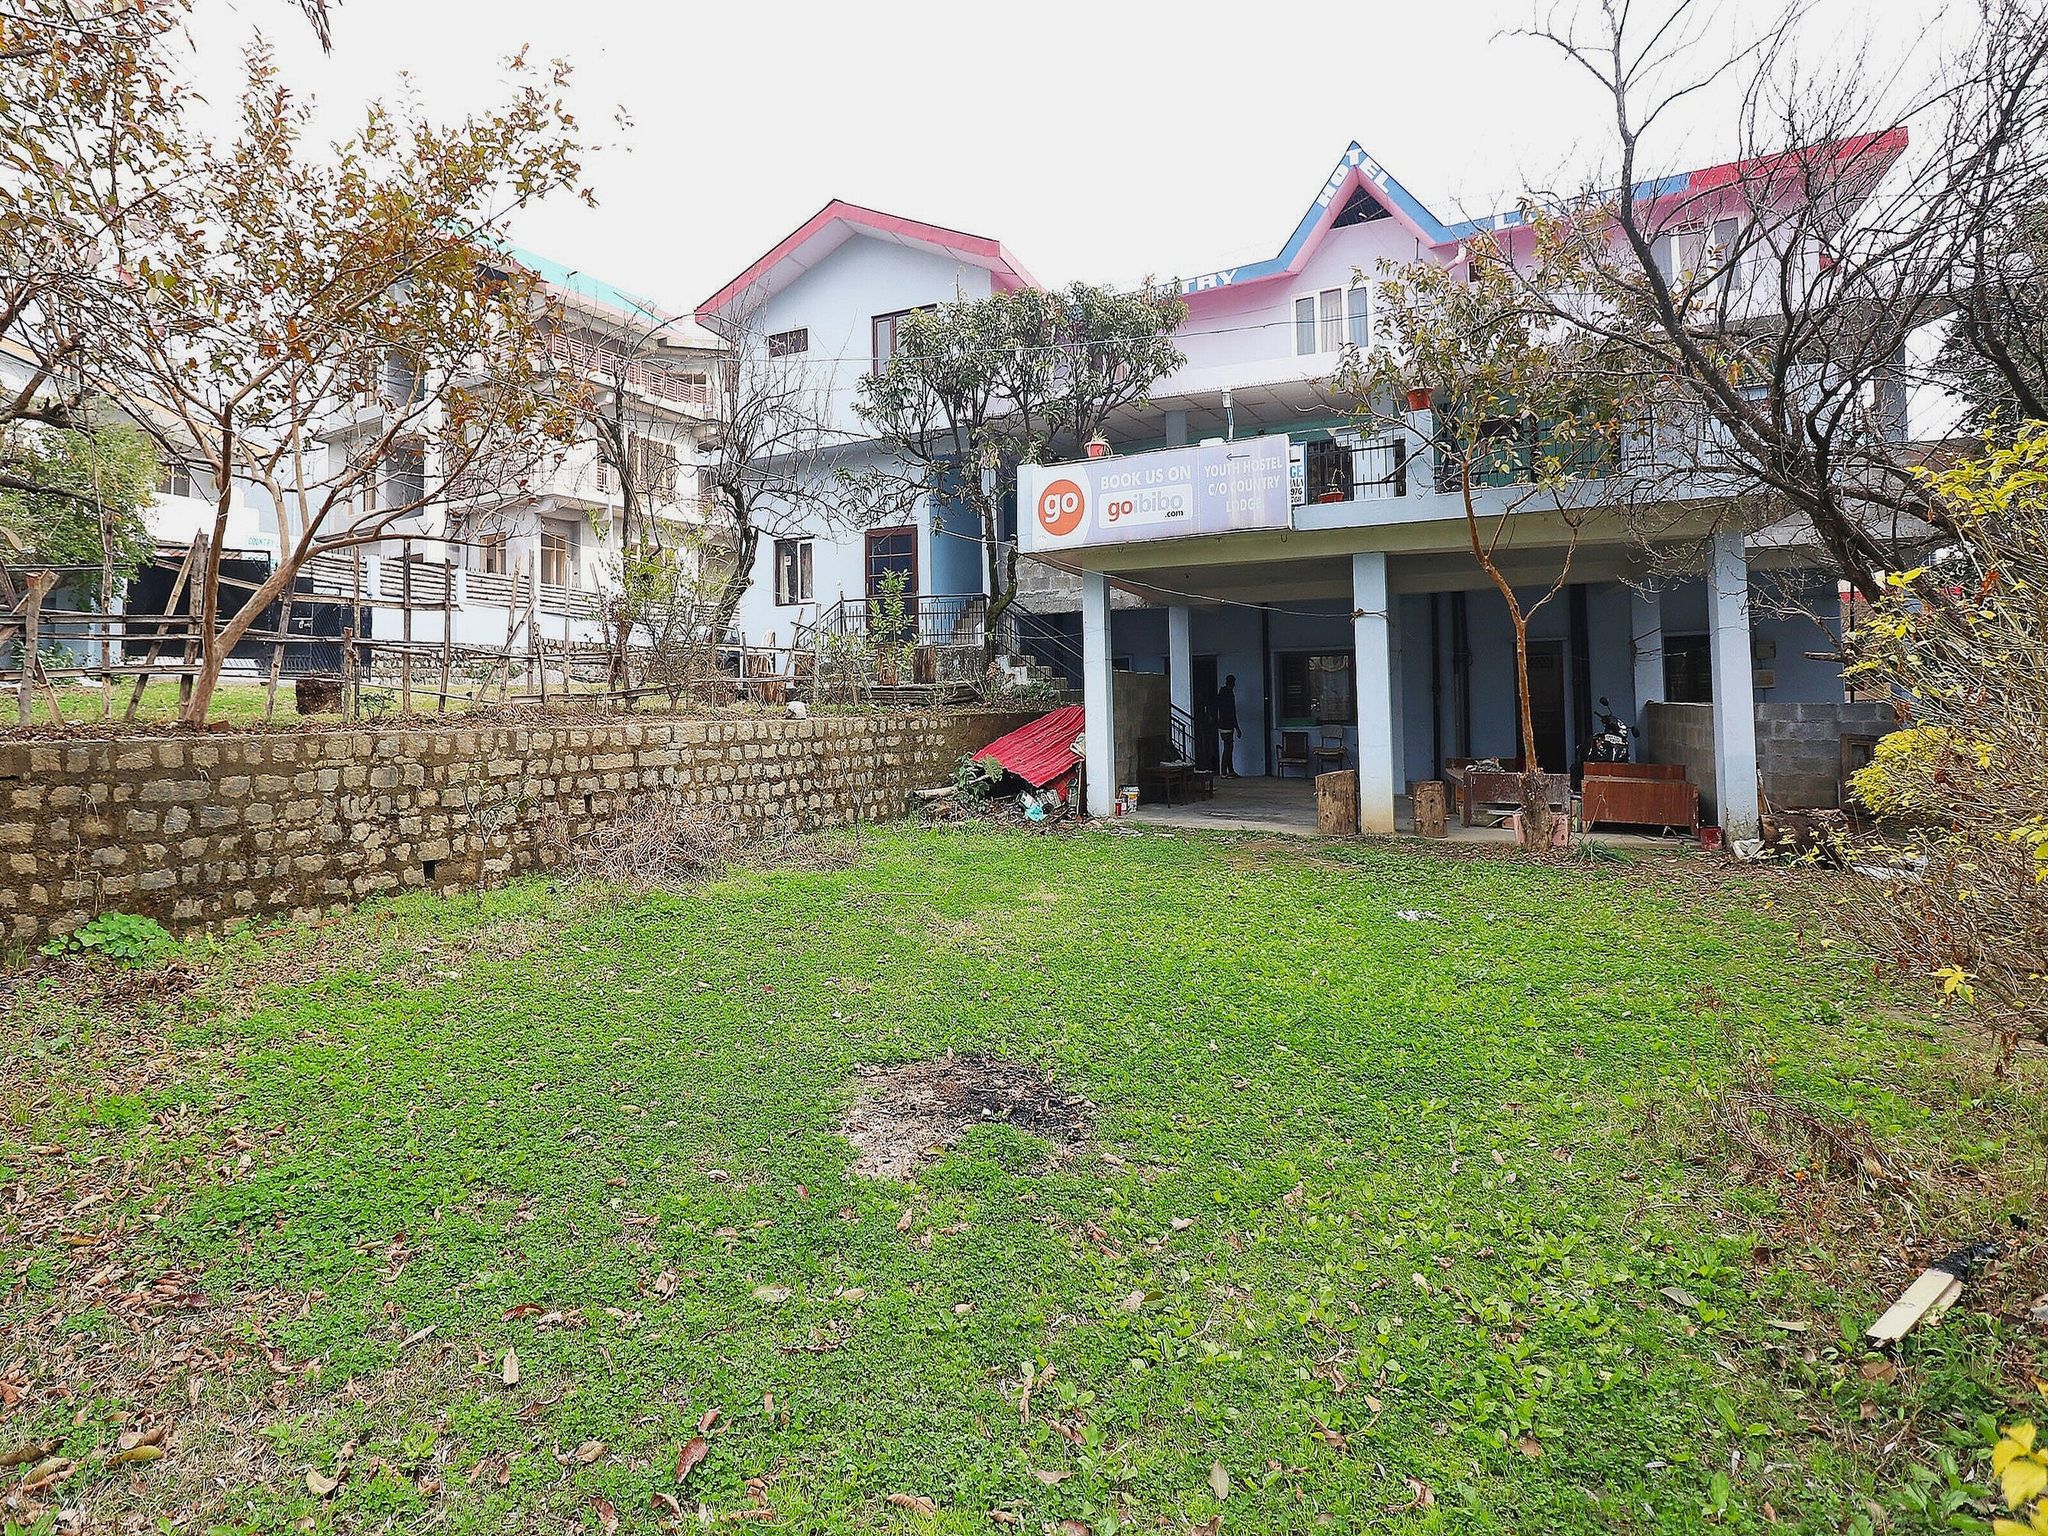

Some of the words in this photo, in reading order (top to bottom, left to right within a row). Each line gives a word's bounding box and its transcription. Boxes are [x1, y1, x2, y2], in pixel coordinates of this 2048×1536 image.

[1101, 472, 1141, 490] BOOK
[1146, 468, 1164, 484] US
[1168, 464, 1191, 481] ON
[1204, 462, 1240, 478] YOUTH
[1243, 456, 1283, 473] HOSTEL
[1208, 482, 1227, 496] C/O
[1231, 475, 1280, 492] COUNTRY
[1043, 491, 1079, 524] go
[1108, 491, 1183, 522] goibibo
[1165, 510, 1184, 518] .com
